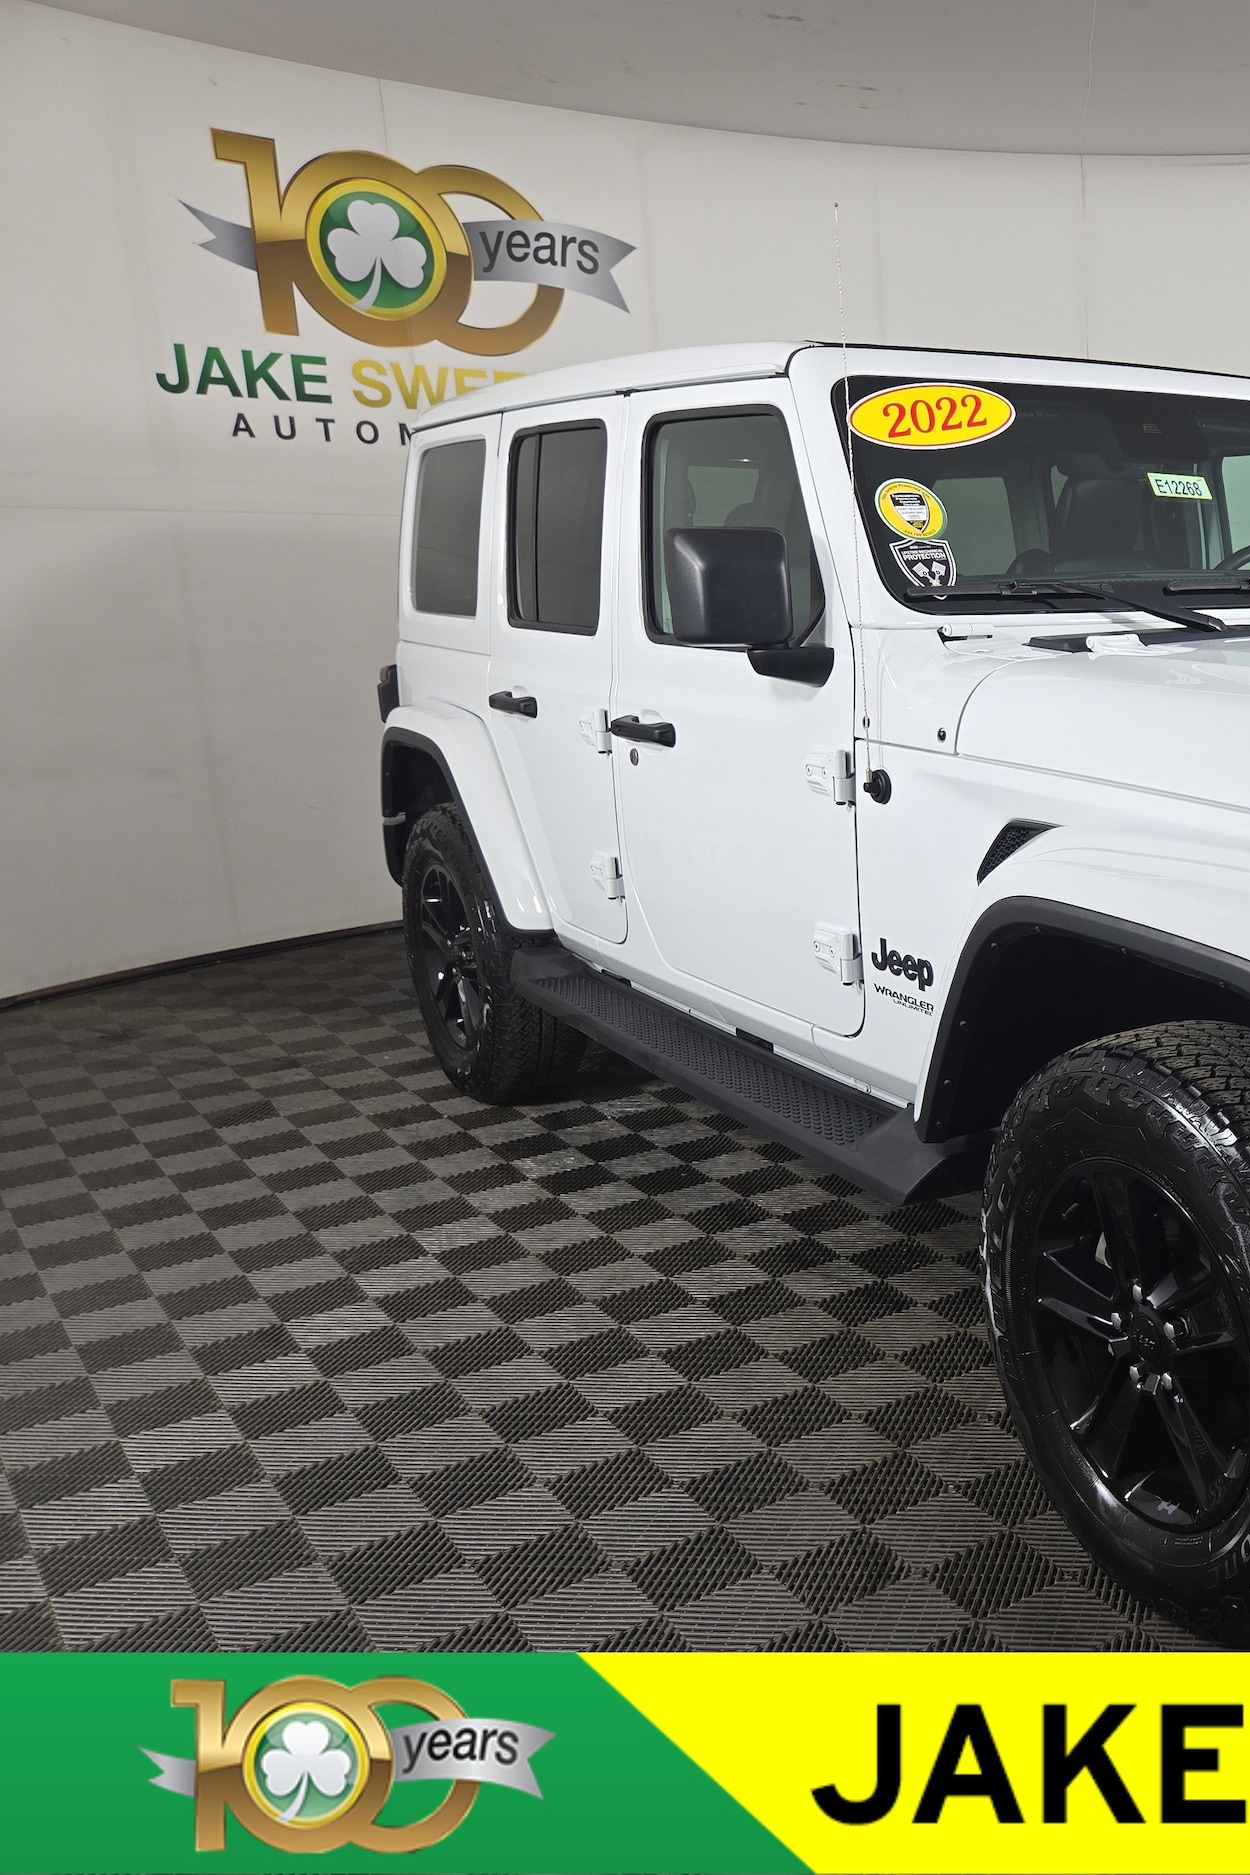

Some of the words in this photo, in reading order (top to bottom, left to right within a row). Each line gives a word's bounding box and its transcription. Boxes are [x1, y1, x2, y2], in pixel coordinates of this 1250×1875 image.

[210, 127, 565, 357] 100
[478, 226, 601, 275] years
[155, 342, 333, 404] JAKE
[351, 358, 527, 410] SWE
[882, 394, 988, 439] 2022
[1154, 478, 1203, 497] E12268
[902, 551, 946, 562] PROTECTION
[871, 937, 934, 992] Jeep
[873, 982, 934, 1012] WRANGLER
